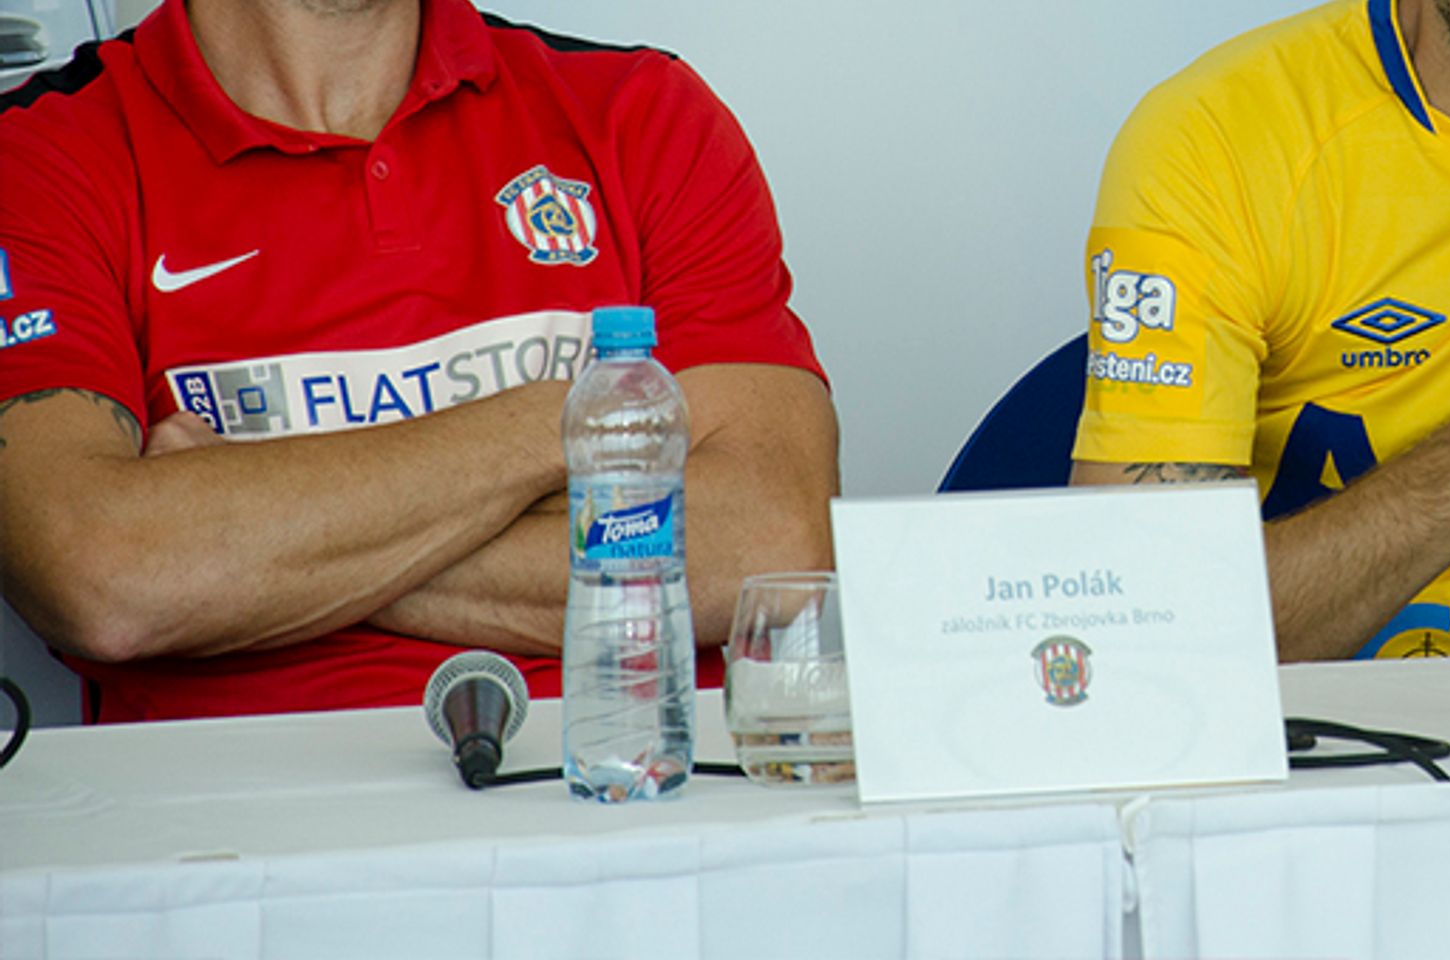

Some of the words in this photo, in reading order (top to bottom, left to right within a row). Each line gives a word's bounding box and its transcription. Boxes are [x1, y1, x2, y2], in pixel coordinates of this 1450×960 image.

[1341, 346, 1431, 368] umbro
[598, 510, 659, 544] Toma
[985, 576, 1033, 600] Jan
[1042, 570, 1124, 598] Polák
[1016, 613, 1038, 630] FC
[1041, 610, 1128, 633] Zbrojovka
[1132, 607, 1175, 625] Brno
